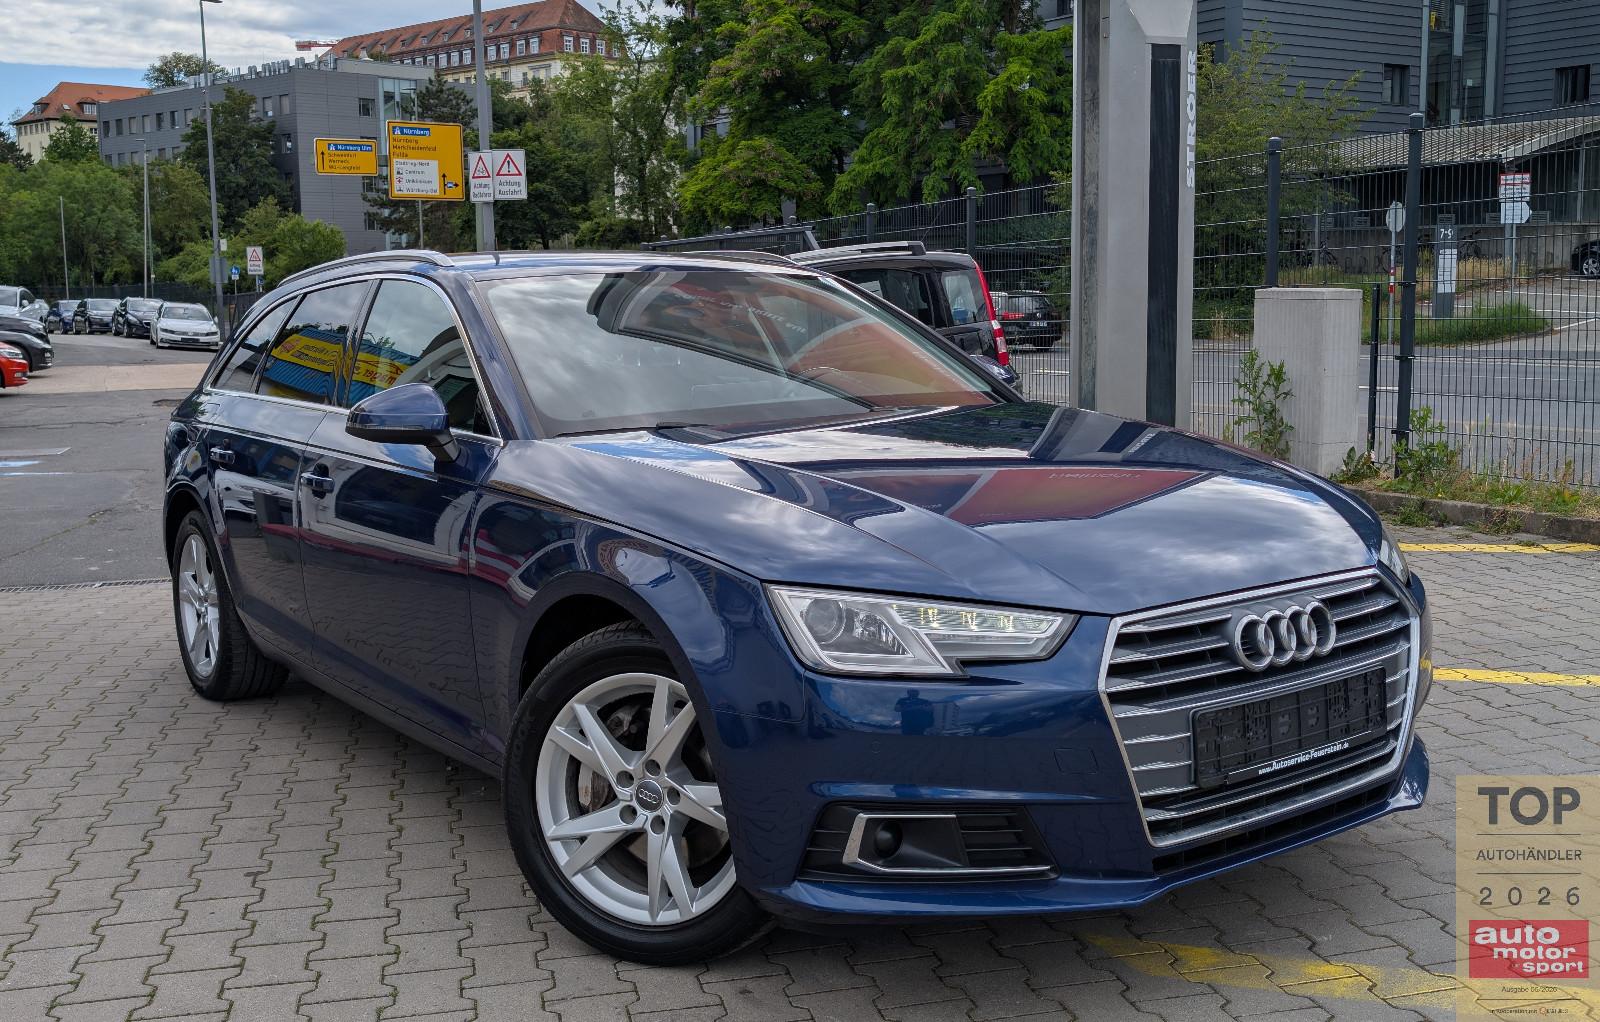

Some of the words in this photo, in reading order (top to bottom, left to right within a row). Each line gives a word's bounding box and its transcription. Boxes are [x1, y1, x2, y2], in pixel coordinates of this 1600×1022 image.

[403, 128, 430, 136] Nürnberg
[498, 180, 521, 188] Achtung
[498, 188, 523, 196] Ausfahrt
